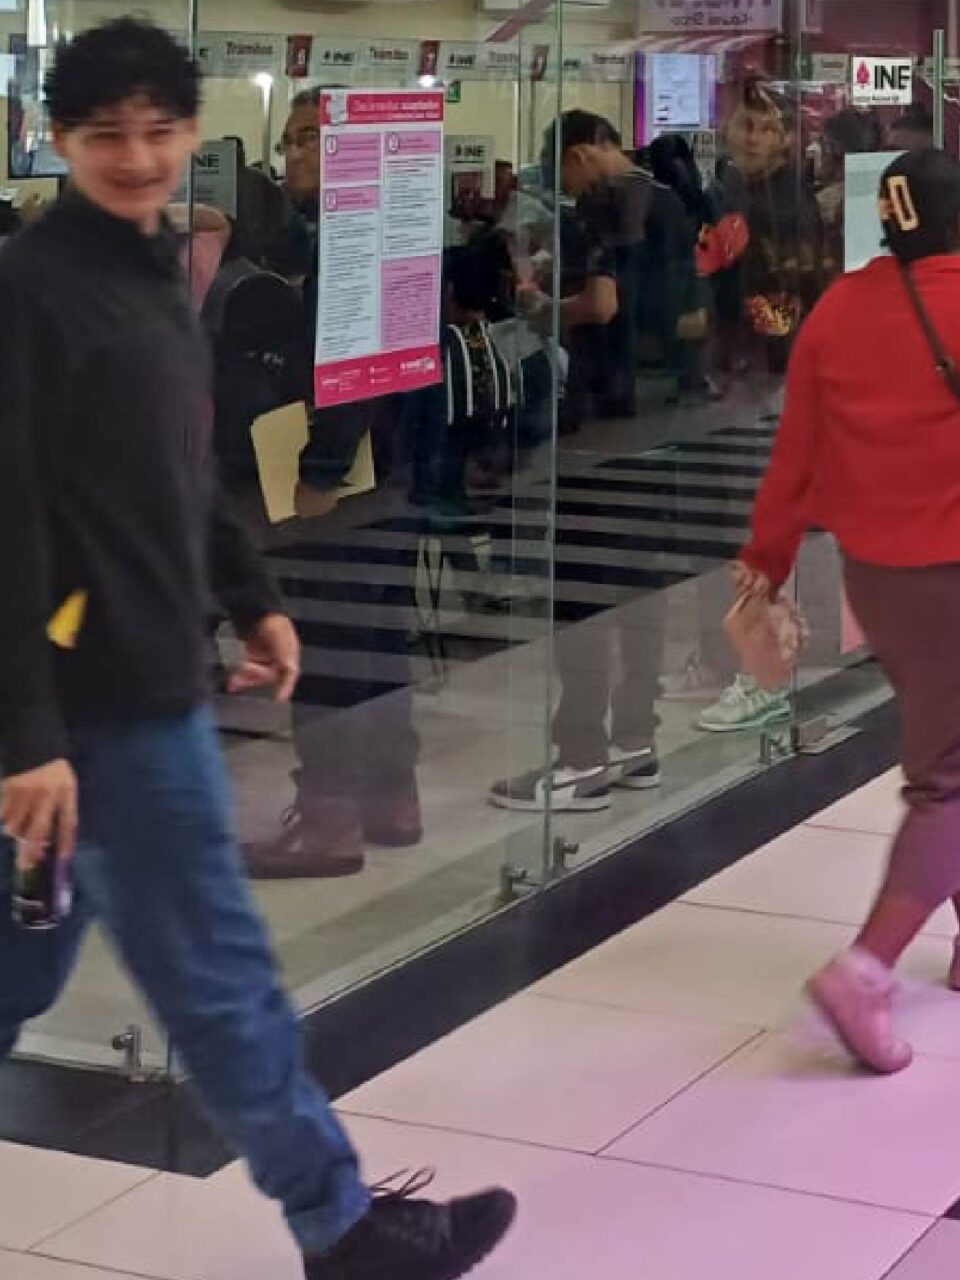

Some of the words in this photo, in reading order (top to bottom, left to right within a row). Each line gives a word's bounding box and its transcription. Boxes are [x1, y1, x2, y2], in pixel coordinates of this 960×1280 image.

[874, 65, 910, 90] INE
[463, 145, 484, 158] INE
[195, 153, 220, 169] NE
